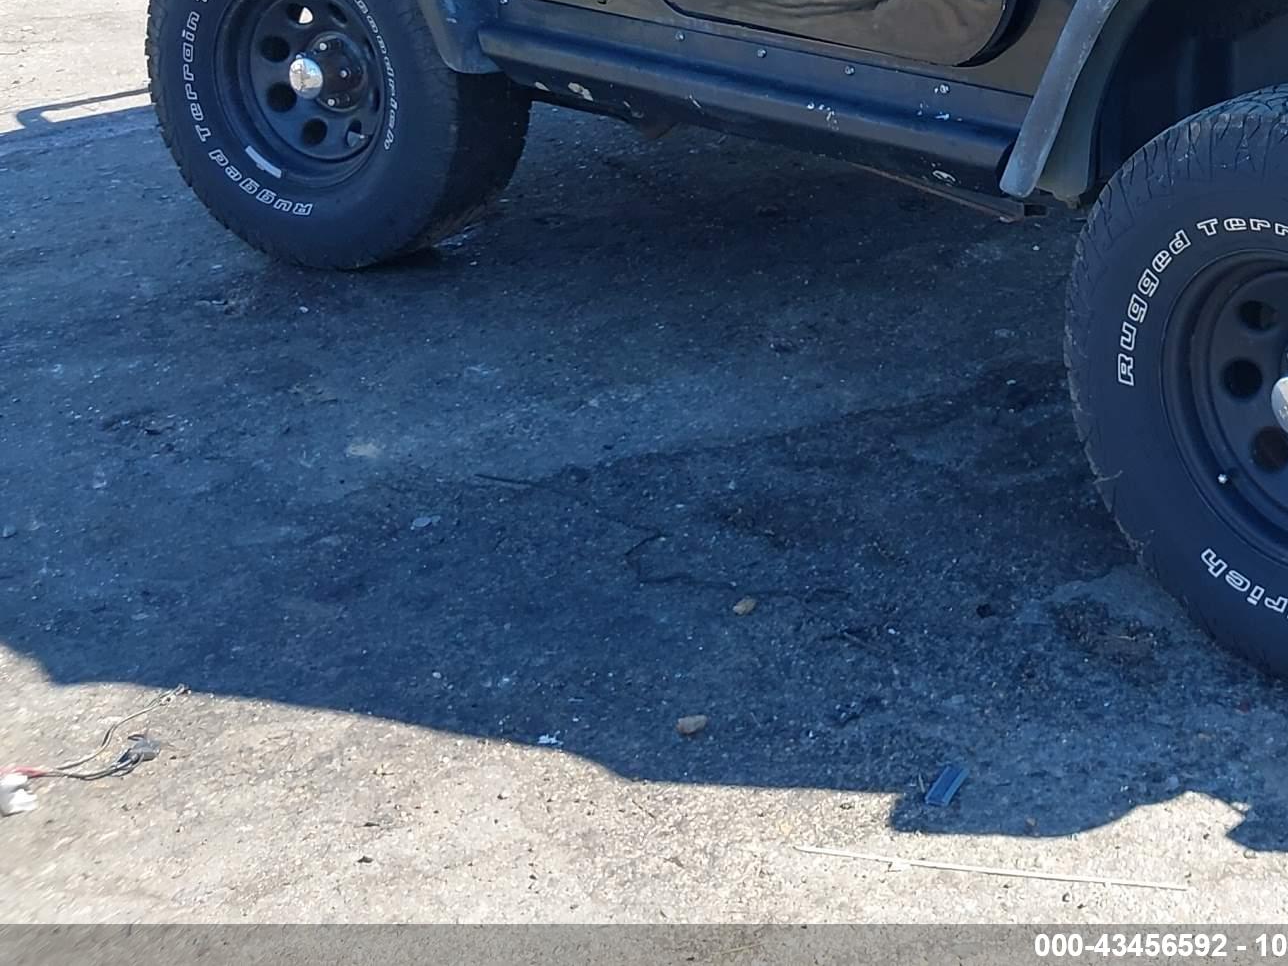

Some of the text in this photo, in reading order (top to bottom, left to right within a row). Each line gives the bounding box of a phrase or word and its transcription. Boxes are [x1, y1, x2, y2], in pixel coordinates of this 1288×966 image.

[182, 10, 212, 143] Terrain
[208, 148, 313, 217] Rugged
[1117, 229, 1191, 386] Rugged
